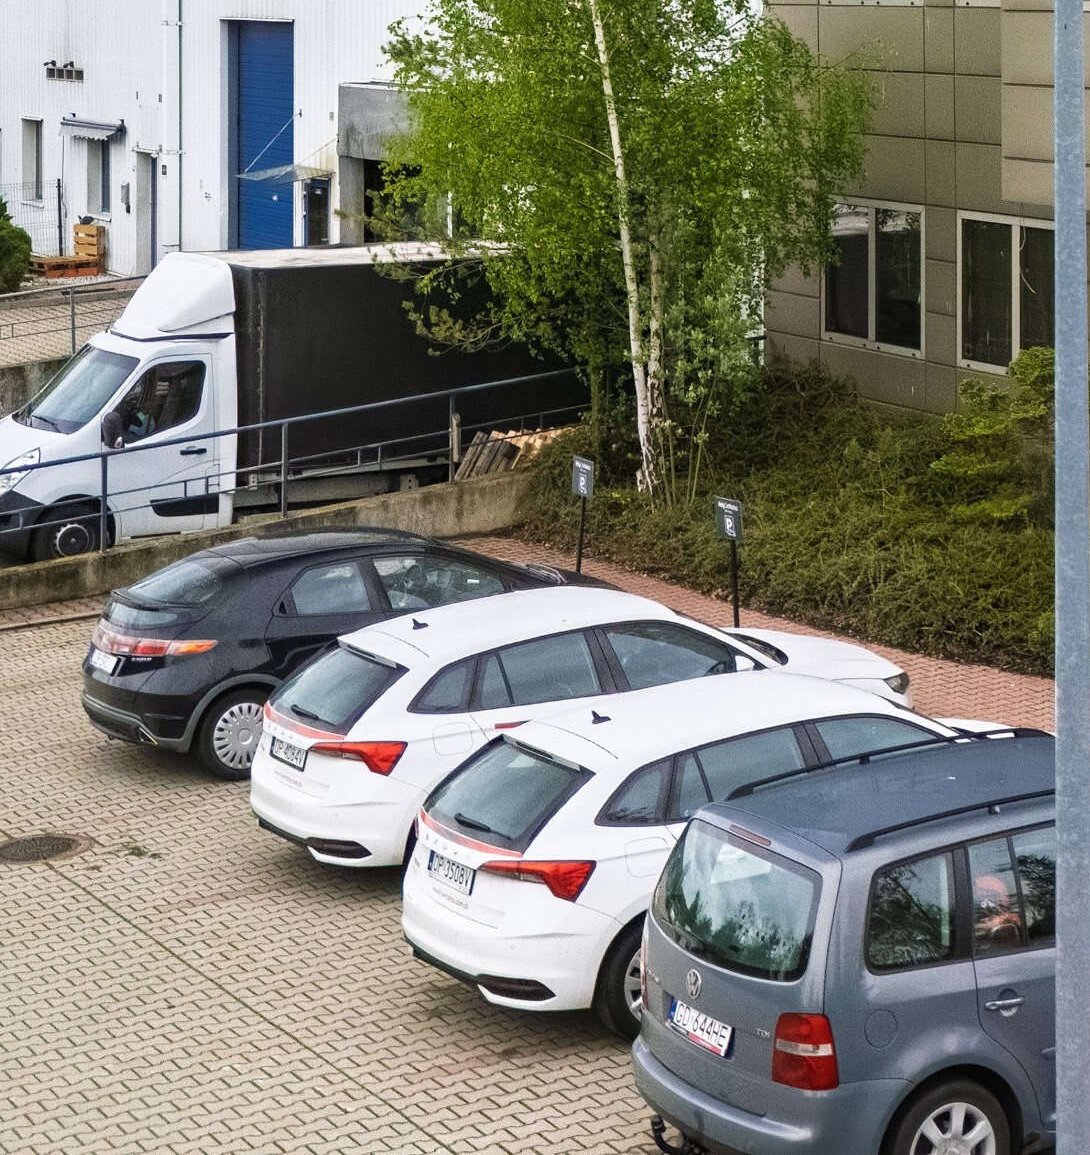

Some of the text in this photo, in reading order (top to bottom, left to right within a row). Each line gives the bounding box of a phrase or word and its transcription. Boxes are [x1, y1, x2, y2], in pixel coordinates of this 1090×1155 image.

[444, 860, 471, 887] 3508V
[675, 1003, 691, 1026] GD
[692, 1012, 729, 1048] 644HE
